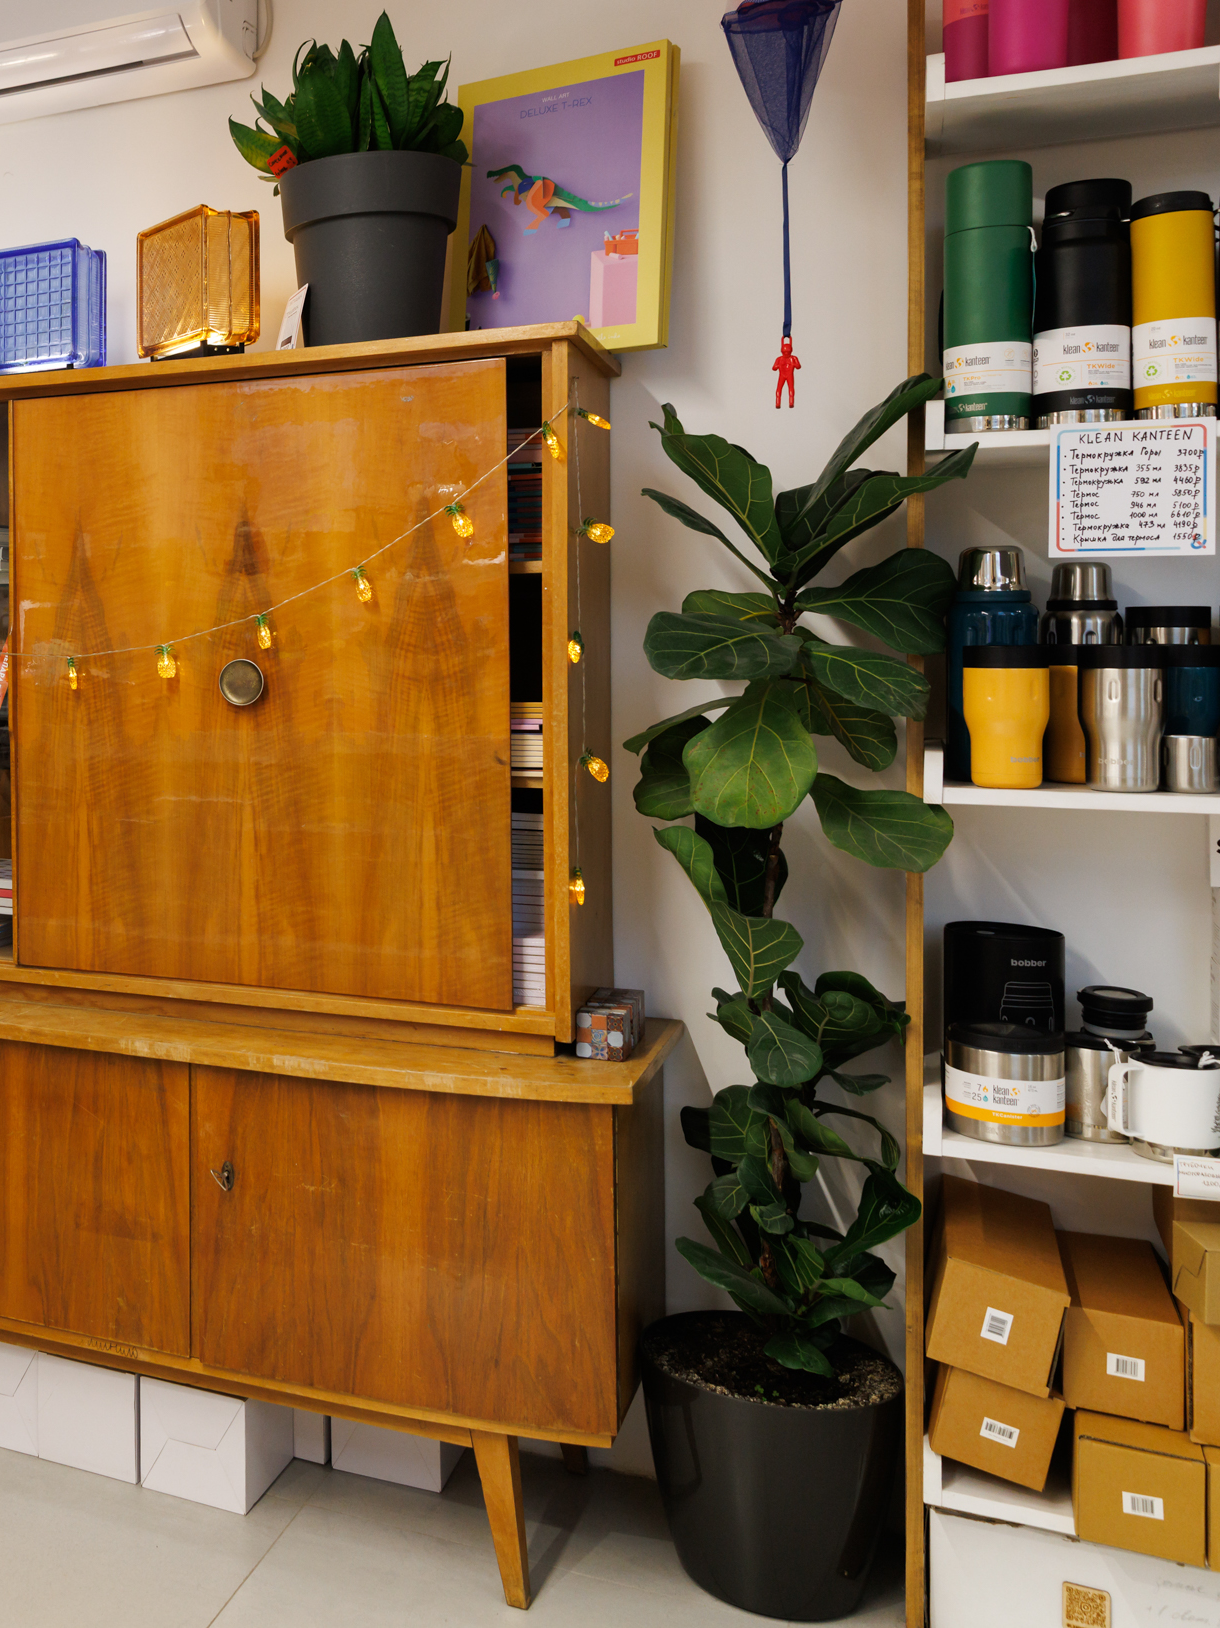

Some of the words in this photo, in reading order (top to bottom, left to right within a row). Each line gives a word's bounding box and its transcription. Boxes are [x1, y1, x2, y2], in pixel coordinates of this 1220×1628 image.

[616, 55, 635, 65] studio
[637, 51, 658, 61] ROOF
[541, 95, 557, 103] WALL
[520, 103, 558, 119] DELUXE
[562, 96, 592, 111] T-REX
[1063, 344, 1080, 355] klean
[1096, 342, 1119, 352] kanteen
[1149, 339, 1166, 349] klean
[1183, 335, 1208, 345] kanteen
[965, 356, 990, 367] kanteen
[1079, 431, 1123, 444] KLEAN
[1132, 428, 1193, 442] KANTEEN
[1069, 448, 1134, 465] Термокружка
[1140, 447, 1161, 460] Горы
[1069, 464, 1128, 479] Термокружка
[1136, 463, 1151, 472] 355
[1070, 477, 1123, 491] Термокружка
[1134, 477, 1150, 485] 592
[1071, 489, 1100, 504] Термос
[1131, 490, 1145, 498] 750
[1070, 500, 1099, 514] Термос
[1130, 501, 1144, 509] 946
[1070, 511, 1100, 525] Термос
[1130, 511, 1146, 519] 1000
[1073, 522, 1130, 535] Термокружка
[1138, 520, 1155, 529] 473
[1073, 533, 1107, 547] Крышка
[1111, 533, 1125, 542] для
[1128, 534, 1160, 545] термоса
[1010, 755, 1040, 764] bobber
[1098, 757, 1133, 766] bobber
[1010, 958, 1047, 967] bobber
[971, 1093, 982, 1101] 25
[992, 1084, 1010, 1096] klean
[992, 1095, 1018, 1106] kanteen
[992, 1112, 1023, 1120] TKCanister
